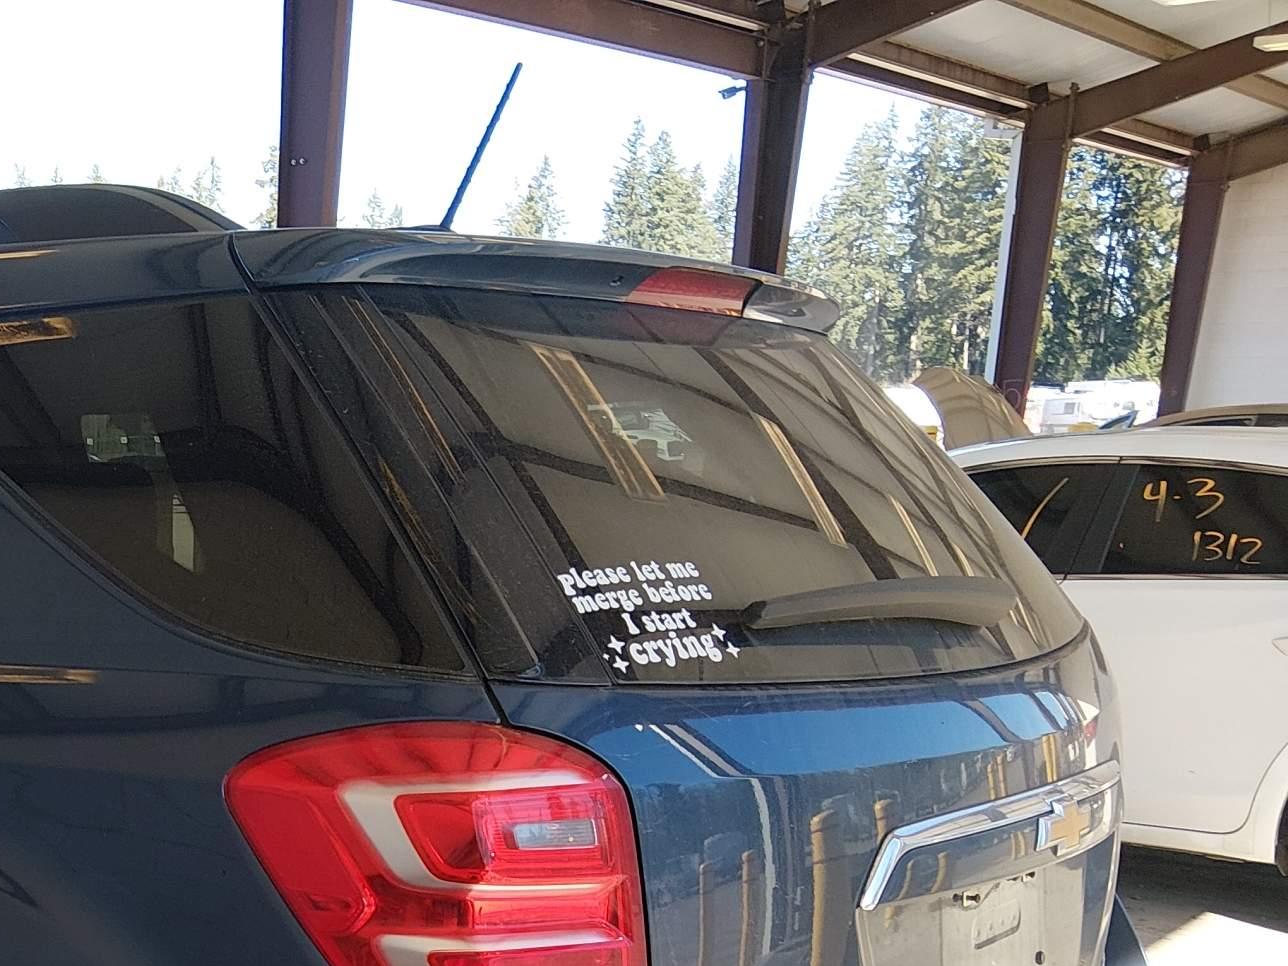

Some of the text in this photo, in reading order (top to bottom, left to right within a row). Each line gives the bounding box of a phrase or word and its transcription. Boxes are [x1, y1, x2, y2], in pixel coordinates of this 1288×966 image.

[1191, 530, 1262, 565] 1312
[629, 560, 666, 582] let
[665, 560, 700, 579] me
[571, 580, 713, 614] merge before
[621, 607, 697, 635] I start
[629, 631, 723, 668] crying
